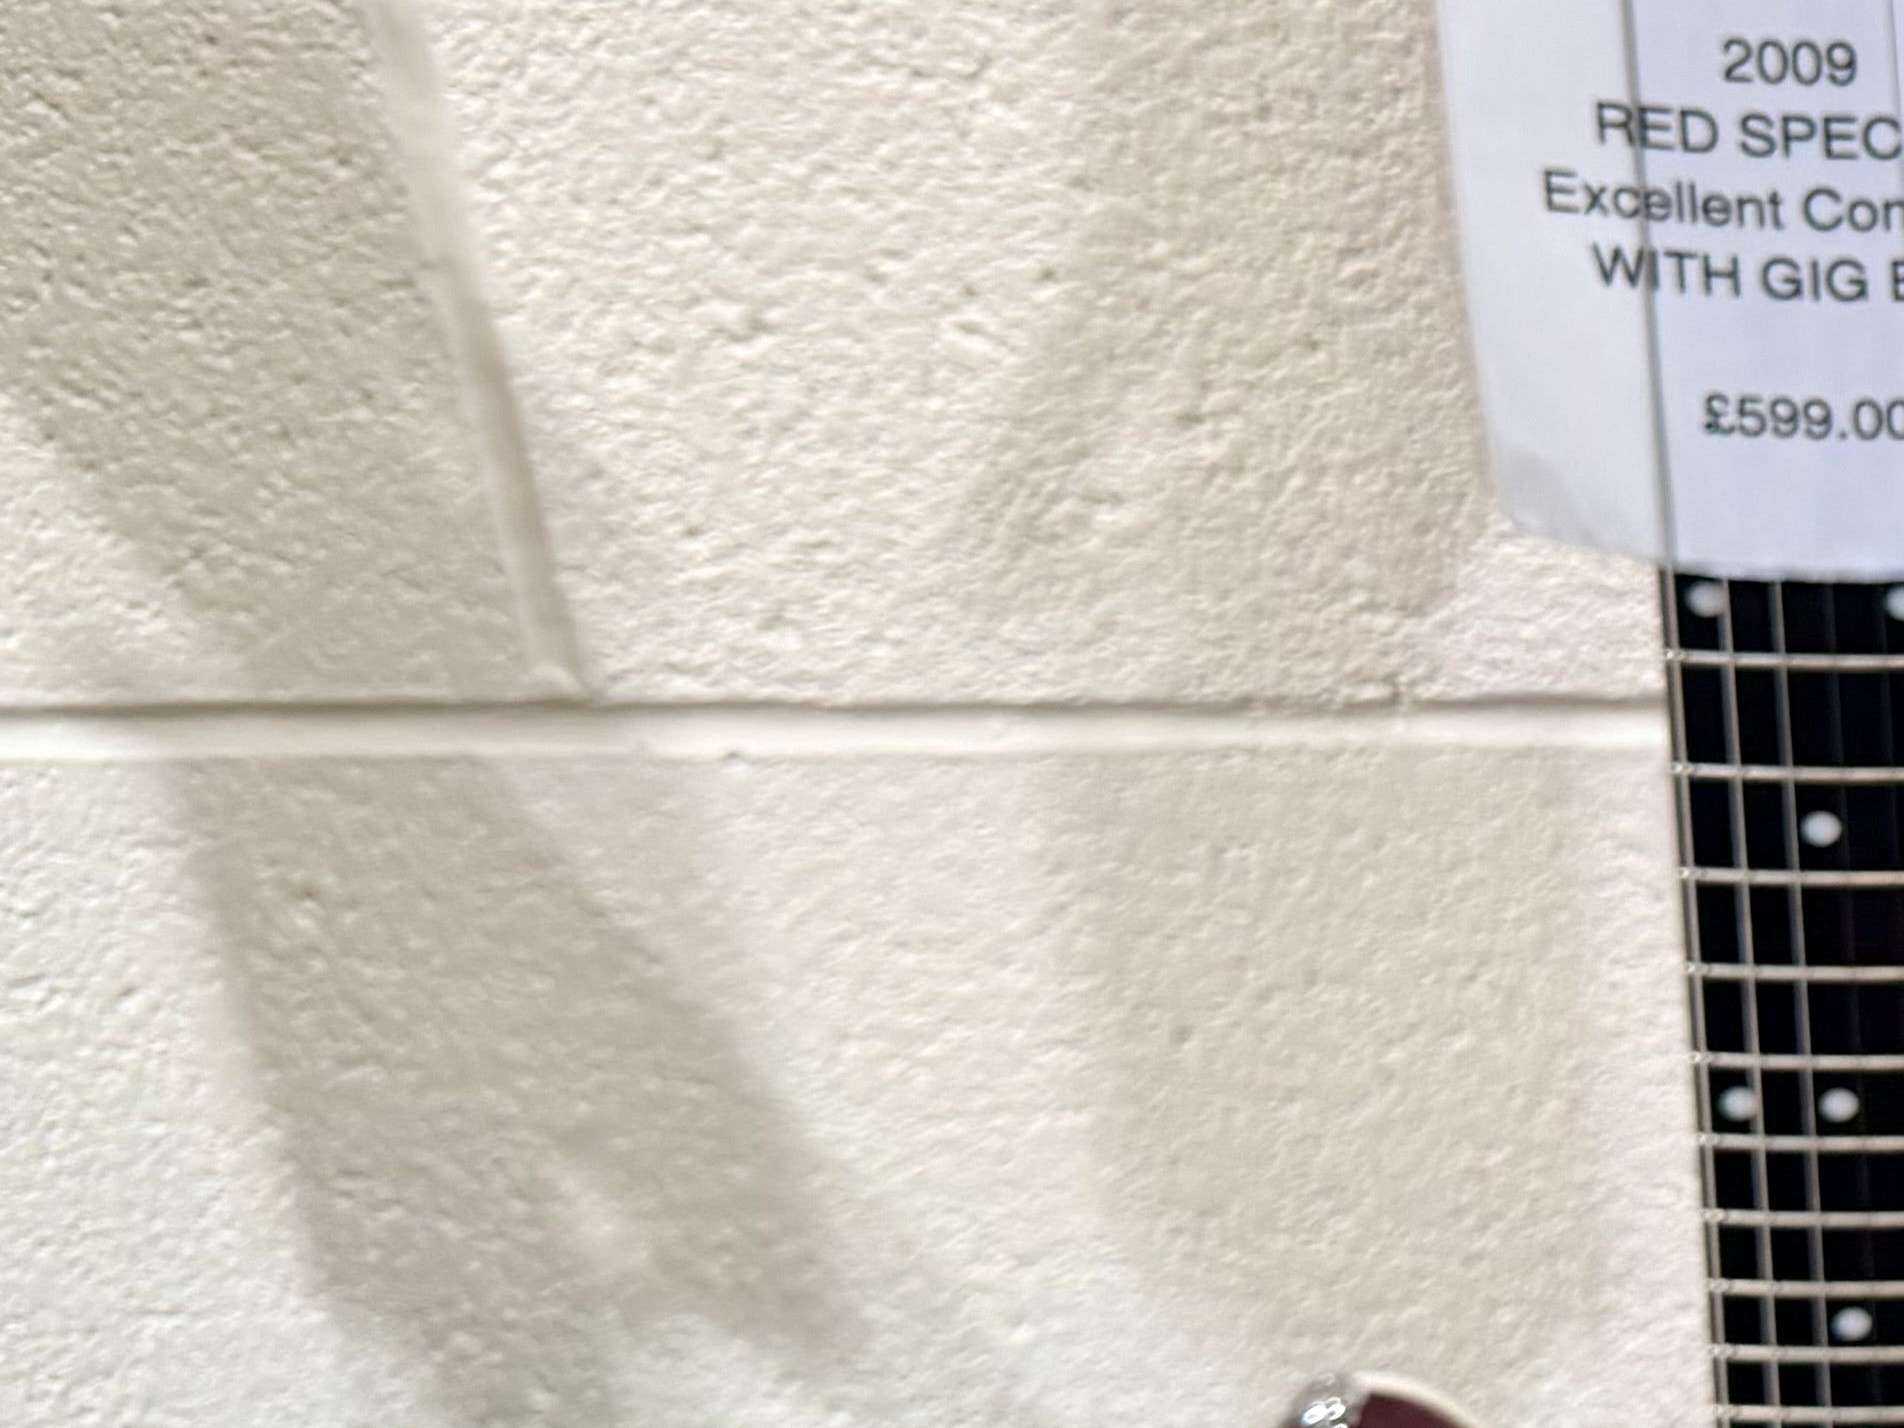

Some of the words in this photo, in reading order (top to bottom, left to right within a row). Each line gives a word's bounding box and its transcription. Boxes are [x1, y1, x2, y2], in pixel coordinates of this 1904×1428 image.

[1722, 35, 1858, 88] 2009
[1595, 100, 1720, 155] RED
[1543, 167, 1786, 232] Excellent
[1591, 241, 1743, 299] WITH
[1761, 256, 1870, 303] GIG
